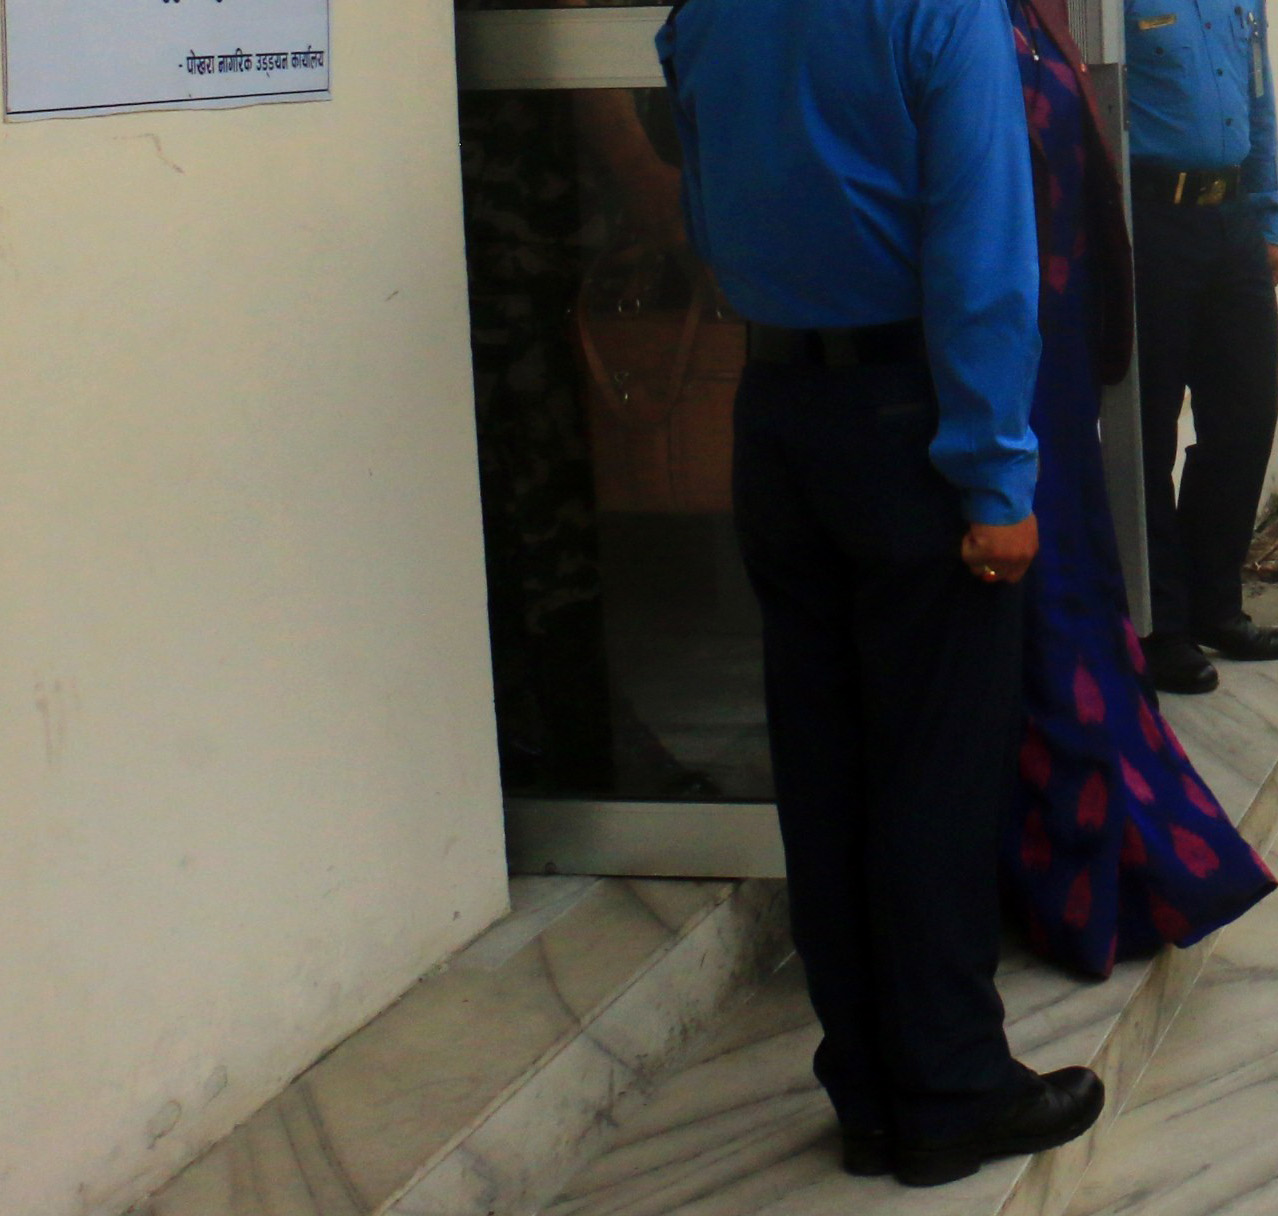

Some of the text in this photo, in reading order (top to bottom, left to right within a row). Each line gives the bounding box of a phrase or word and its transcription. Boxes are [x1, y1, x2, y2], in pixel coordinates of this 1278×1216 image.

[186, 49, 215, 75] पोखरा
[217, 47, 253, 74] नागरिक
[291, 45, 324, 69] कार्यालय
